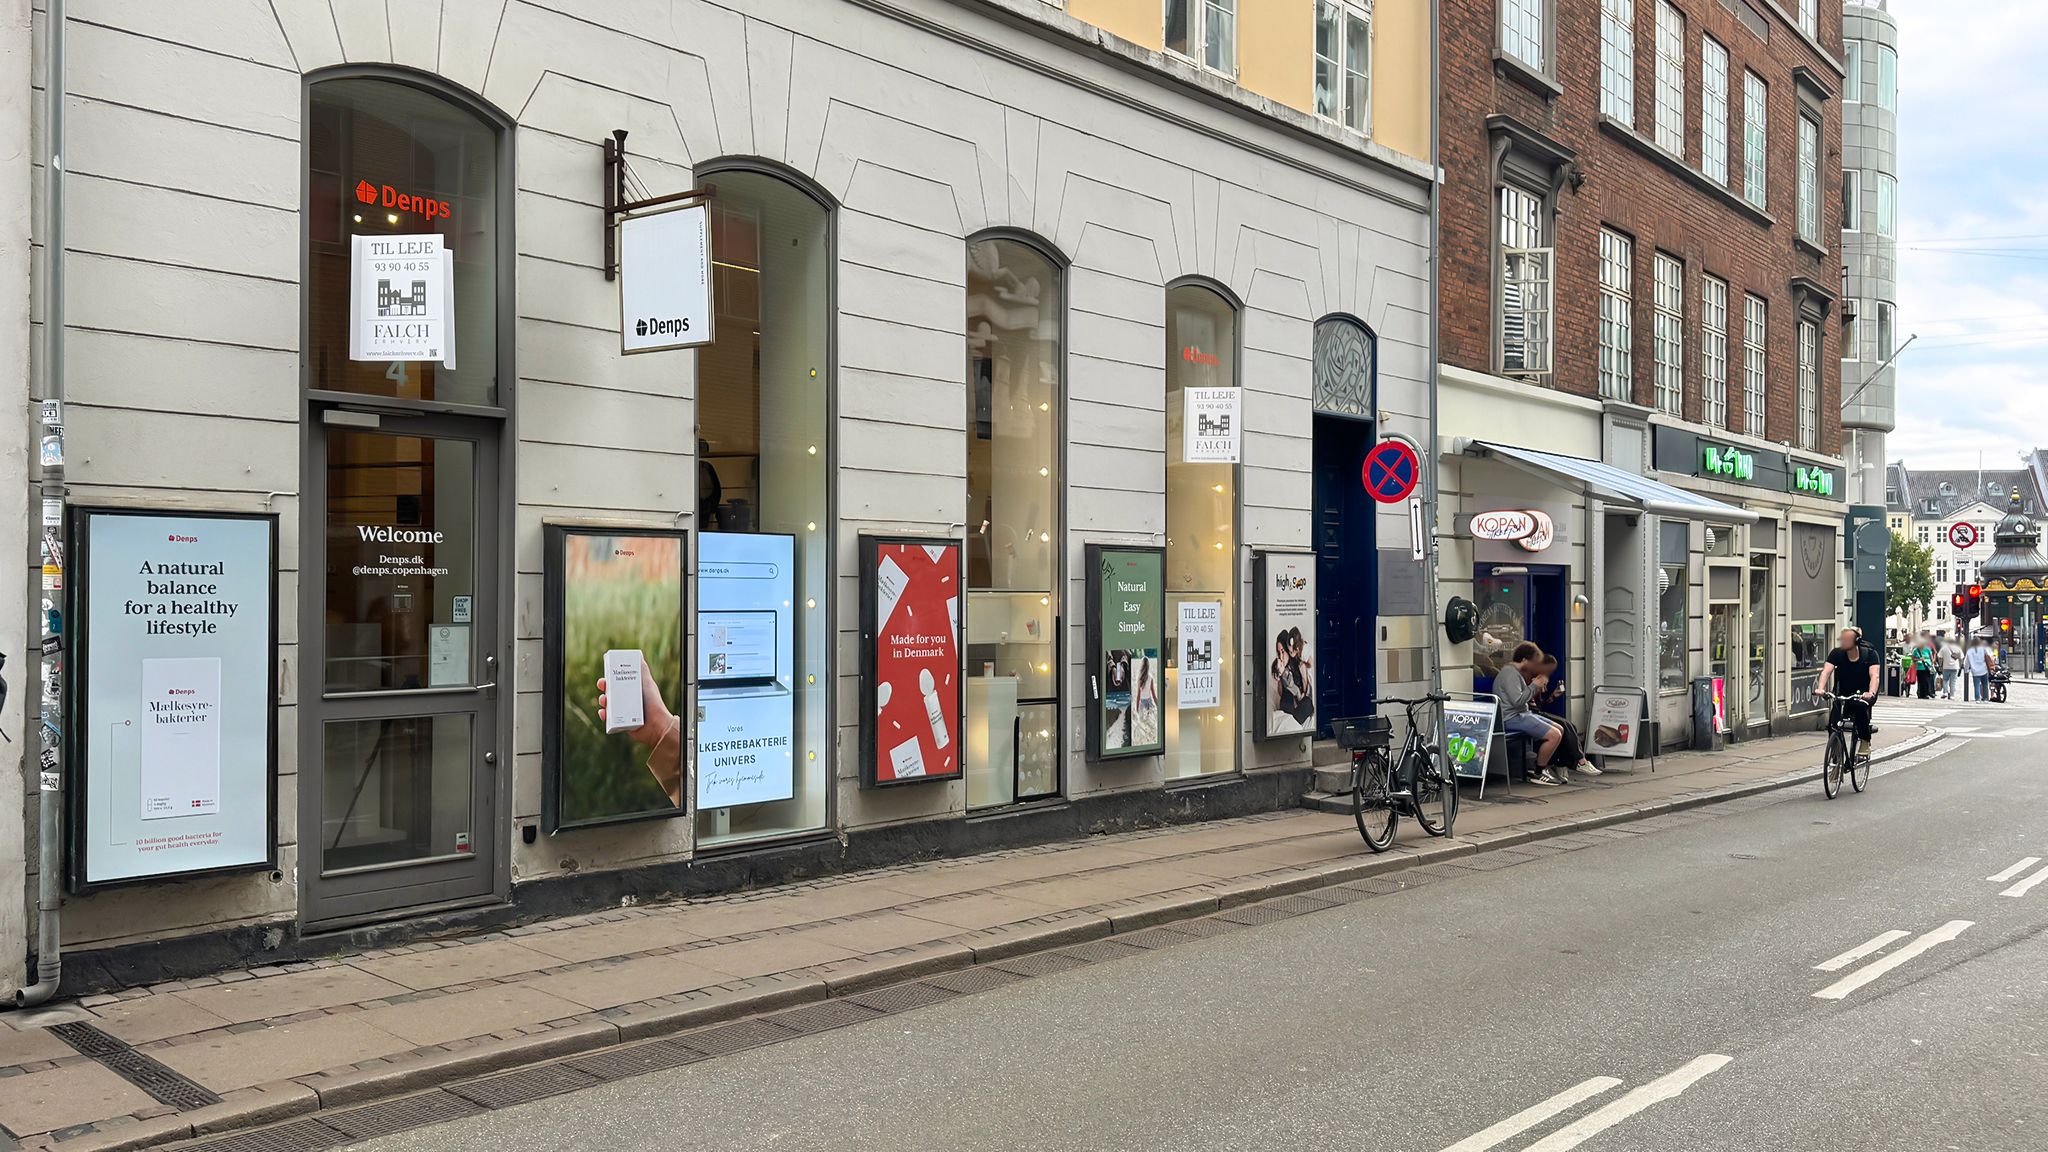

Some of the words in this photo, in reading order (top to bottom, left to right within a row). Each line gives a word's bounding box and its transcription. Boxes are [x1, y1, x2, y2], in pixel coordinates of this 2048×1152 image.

[382, 184, 451, 220] Denps
[371, 242, 394, 254] TIL
[399, 242, 434, 254] LEJE
[375, 262, 386, 271] 93
[389, 262, 400, 271] 90
[404, 262, 416, 271] 40
[418, 262, 430, 271] 55
[374, 324, 429, 338] FALCH
[650, 318, 690, 337] Denps
[386, 361, 408, 386] 4
[1195, 392, 1210, 400] TIL
[1212, 392, 1236, 400] LEJE
[1196, 440, 1232, 450] FALCH
[1477, 517, 1526, 532] KOPAN
[176, 535, 198, 543] Denps
[356, 526, 444, 544] Welcome
[379, 554, 424, 566] Denps.dk
[139, 560, 154, 575] A
[158, 562, 224, 576] natural
[352, 566, 448, 577] @denps_copenhagen
[147, 580, 217, 595] balance
[1118, 582, 1146, 592] Natural
[124, 600, 154, 615] for
[157, 606, 166, 614] a
[171, 600, 238, 618] healthy
[1124, 602, 1140, 614] Easy
[1184, 608, 1196, 619] TIL
[1198, 608, 1216, 619] LEJE
[146, 620, 217, 637] lifestyle
[1118, 621, 1145, 634] Simple
[891, 634, 914, 644] Made
[916, 634, 929, 644] for
[930, 636, 946, 646] you
[893, 648, 902, 658] in
[904, 646, 944, 658] Denmark
[1185, 677, 1213, 689] FALCH
[156, 712, 207, 724] bakterier
[714, 754, 756, 768] UNIVERS
[168, 835, 184, 843] good
[185, 832, 212, 840] bacteria
